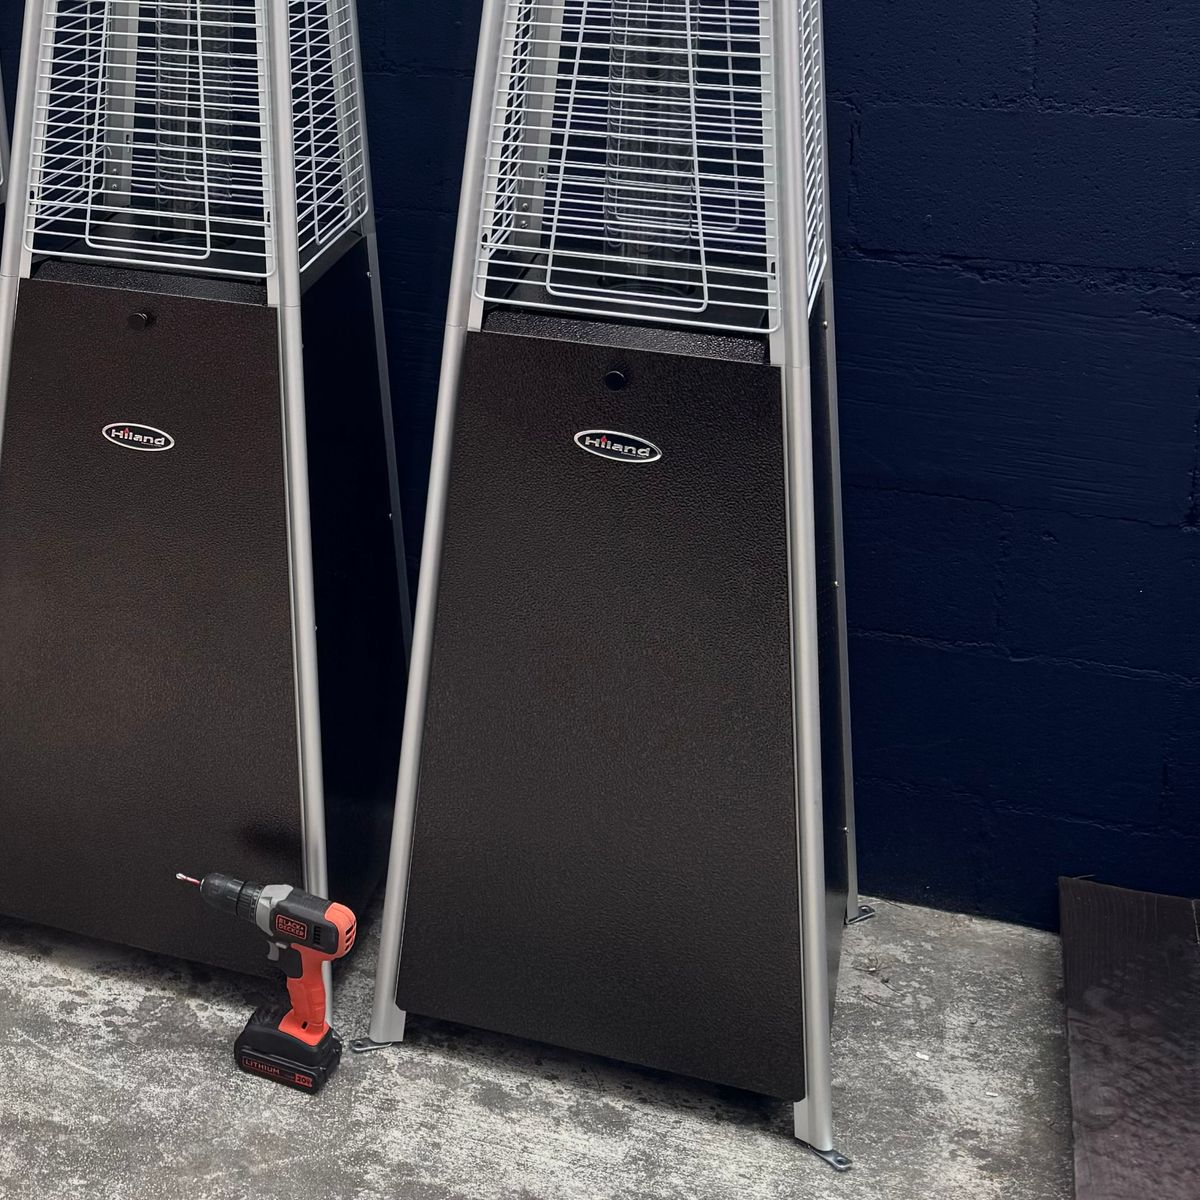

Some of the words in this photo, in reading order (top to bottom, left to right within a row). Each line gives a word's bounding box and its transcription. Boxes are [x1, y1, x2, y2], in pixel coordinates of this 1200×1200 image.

[110, 428, 165, 446] Hiland
[584, 435, 651, 457] Hiland
[278, 923, 304, 937] DECKER
[245, 1058, 281, 1075] LITHIUM
